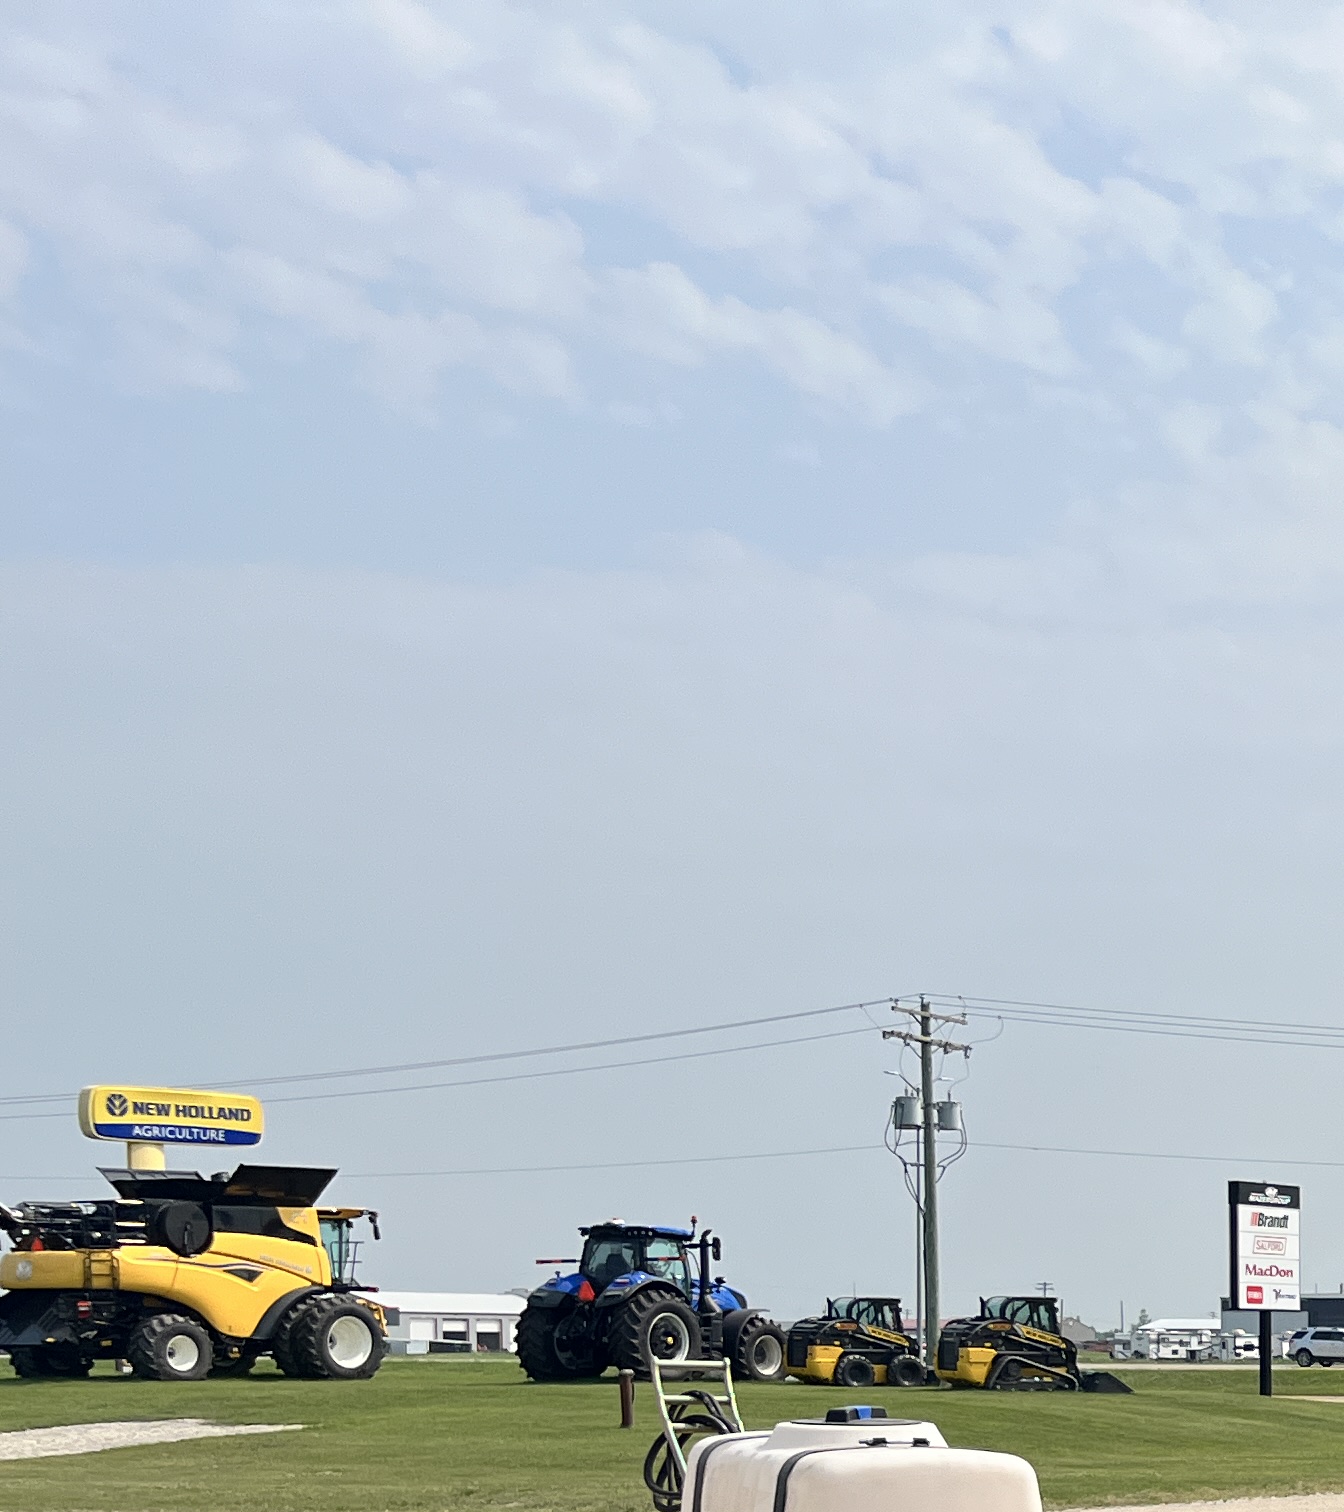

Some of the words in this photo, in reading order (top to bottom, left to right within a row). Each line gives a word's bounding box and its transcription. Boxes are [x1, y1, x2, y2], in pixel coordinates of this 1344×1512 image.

[132, 1101, 171, 1117] NEW
[175, 1103, 252, 1122] HOLLAND
[132, 1125, 226, 1142] AGRICULTURE
[1258, 1212, 1289, 1229] Brandt
[1245, 1263, 1293, 1278] MacDon
